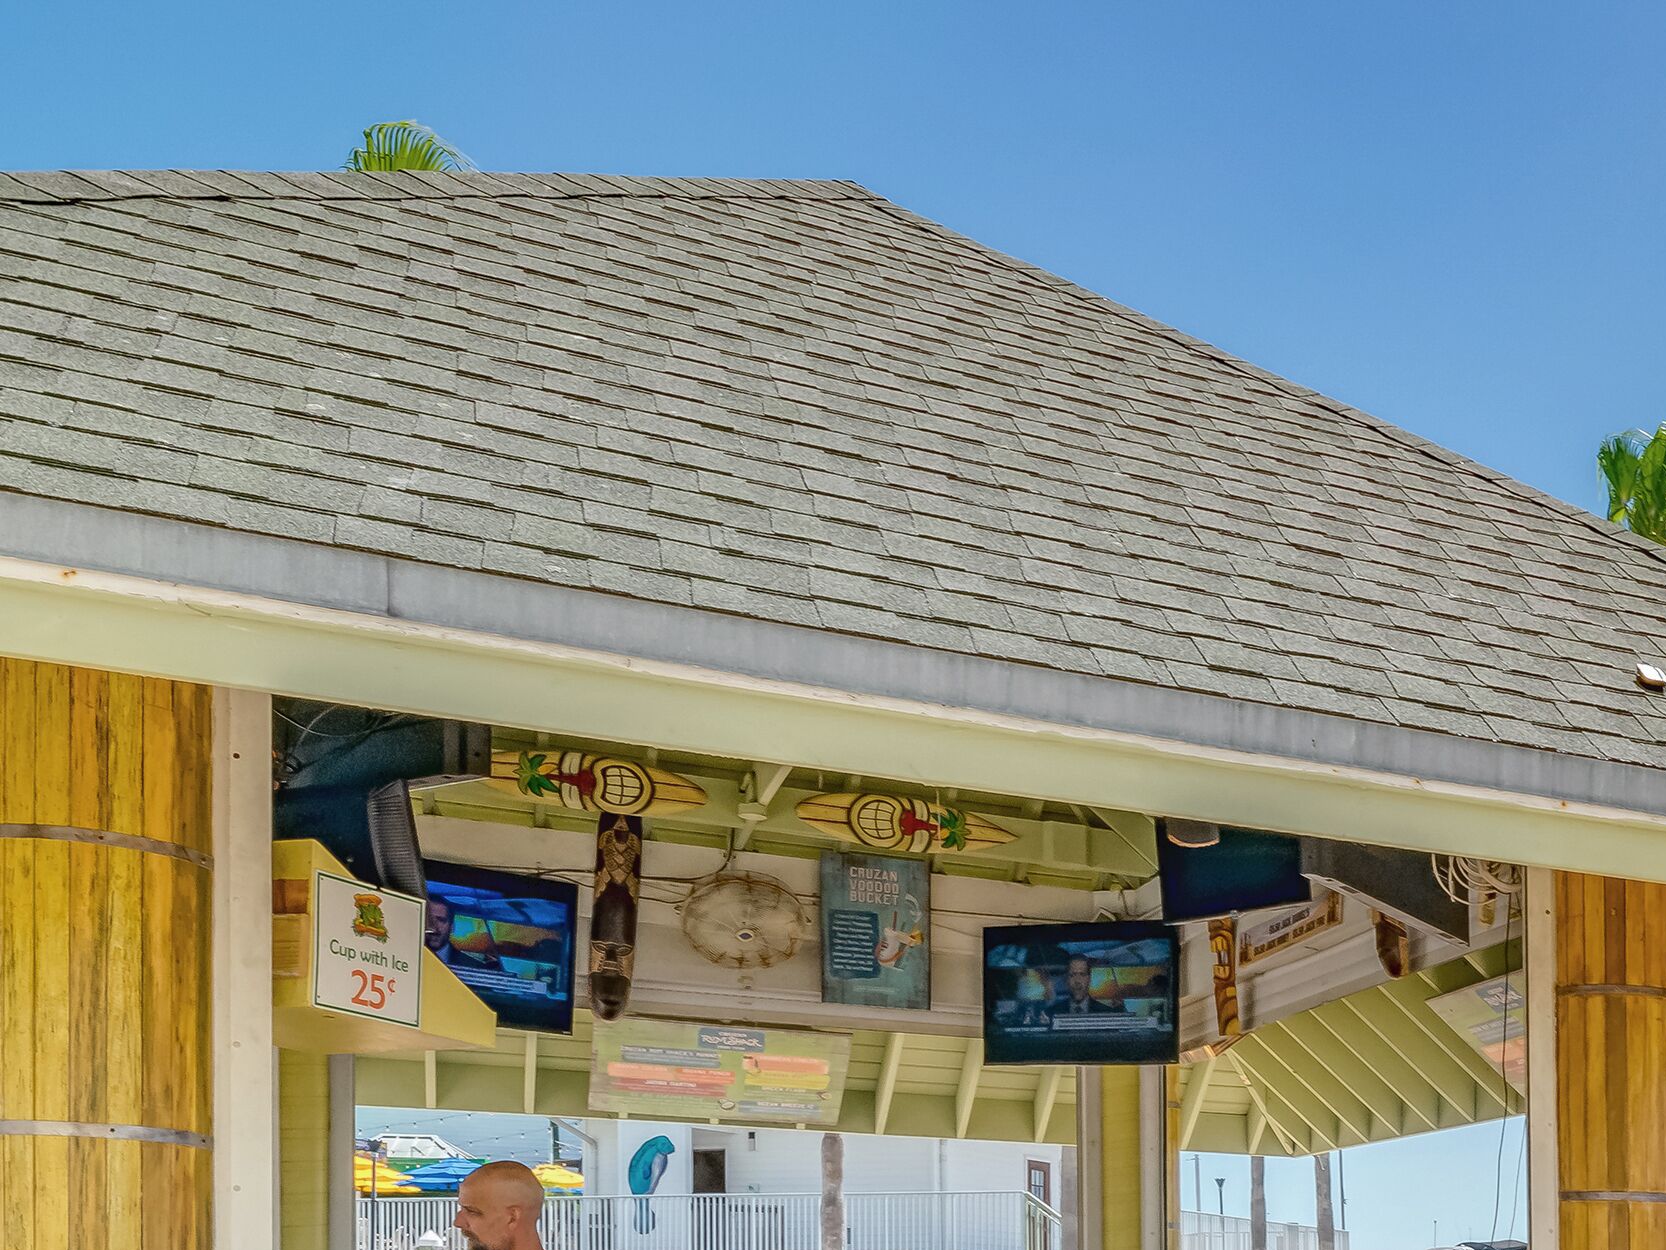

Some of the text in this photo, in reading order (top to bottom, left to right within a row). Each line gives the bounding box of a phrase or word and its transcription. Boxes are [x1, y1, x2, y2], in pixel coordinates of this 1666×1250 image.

[850, 866, 898, 881] CRUZAN
[850, 880, 899, 894] VOODOO
[850, 891, 899, 905] BUCKET
[329, 939, 409, 972] Cup with Ice
[352, 969, 397, 1010] 25¢
